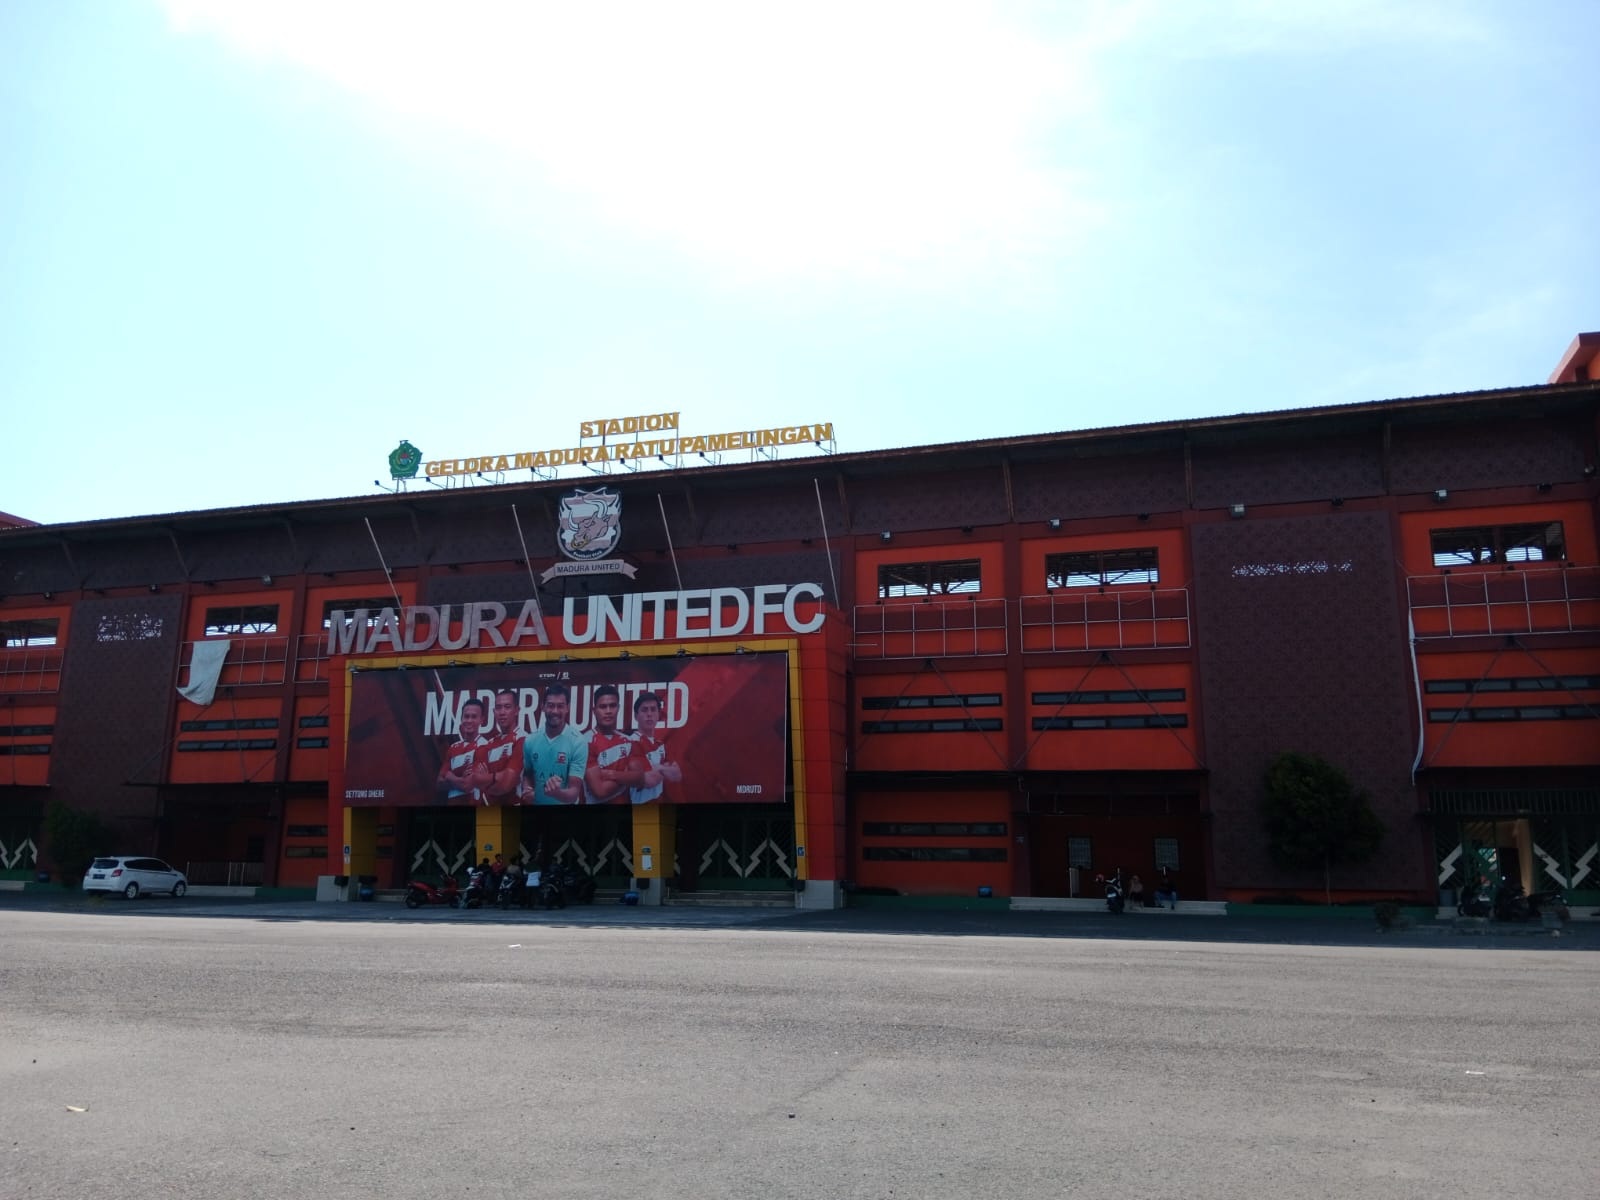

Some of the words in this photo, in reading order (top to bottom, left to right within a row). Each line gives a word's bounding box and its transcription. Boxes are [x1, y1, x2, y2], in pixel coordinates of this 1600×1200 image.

[580, 412, 679, 437] STADION
[425, 455, 509, 477] GELORA
[514, 446, 609, 468] MADURA
[615, 438, 675, 461] RATU
[679, 423, 832, 454] PAMELINGAN
[557, 564, 590, 573] MADURA
[592, 563, 620, 571] UNITED
[327, 599, 551, 655] MADURA
